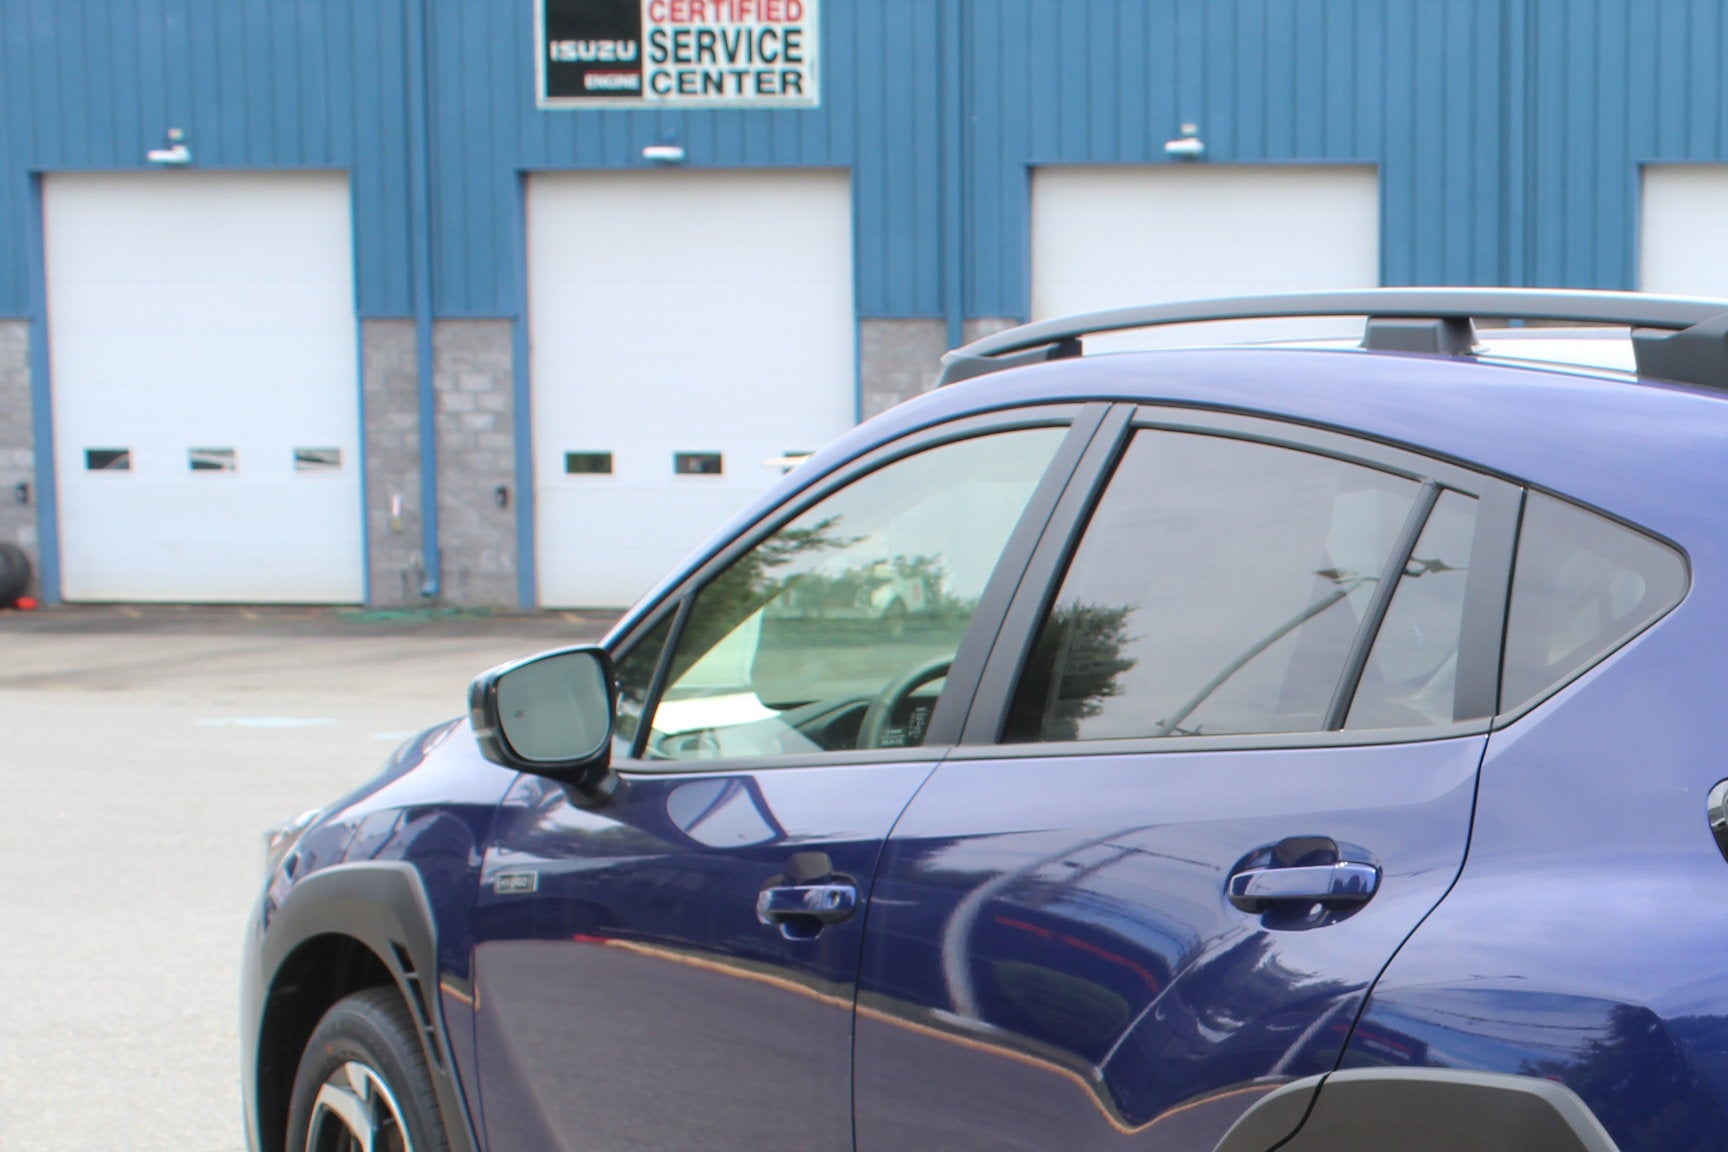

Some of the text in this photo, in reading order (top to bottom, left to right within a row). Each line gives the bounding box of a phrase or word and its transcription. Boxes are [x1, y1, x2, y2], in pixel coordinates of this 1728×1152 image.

[648, 0, 803, 23] CERTIFIED
[550, 40, 638, 62] ISUZU
[649, 28, 803, 64] SERVICE
[584, 73, 641, 90] ENGINE
[650, 69, 803, 95] CENTER
